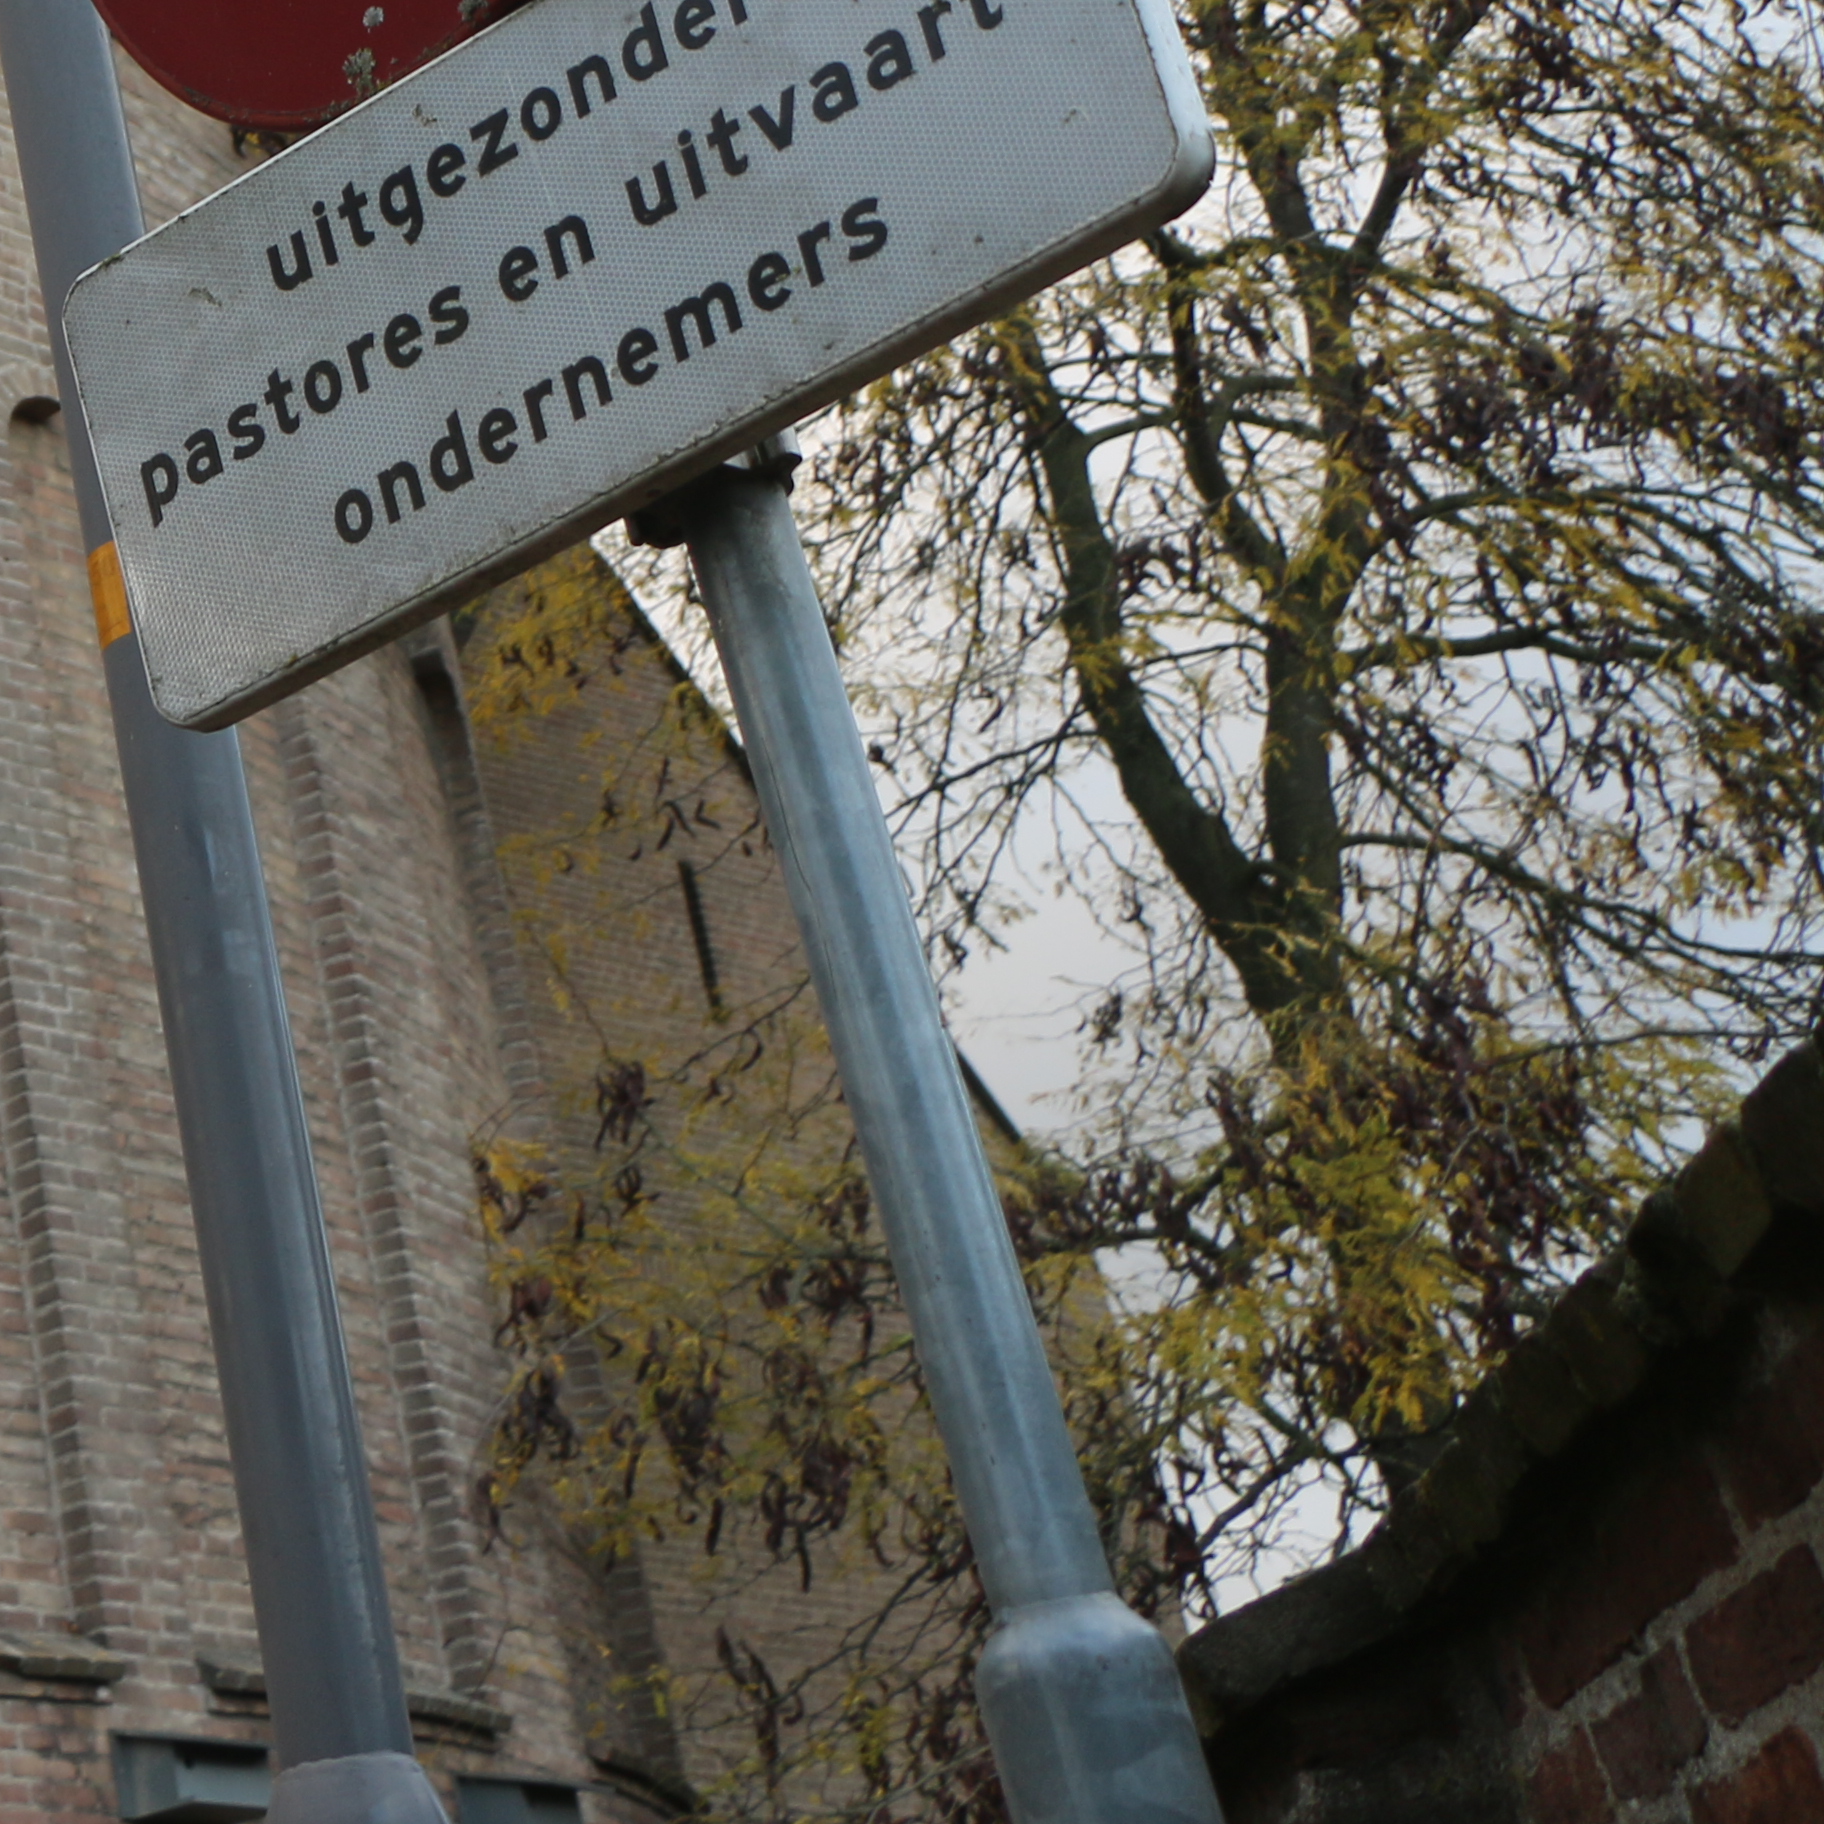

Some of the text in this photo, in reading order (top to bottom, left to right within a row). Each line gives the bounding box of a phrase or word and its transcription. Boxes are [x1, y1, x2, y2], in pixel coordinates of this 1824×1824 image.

[139, 283, 471, 527] pastores
[497, 212, 596, 302] en
[332, 196, 891, 545] ondernemers
